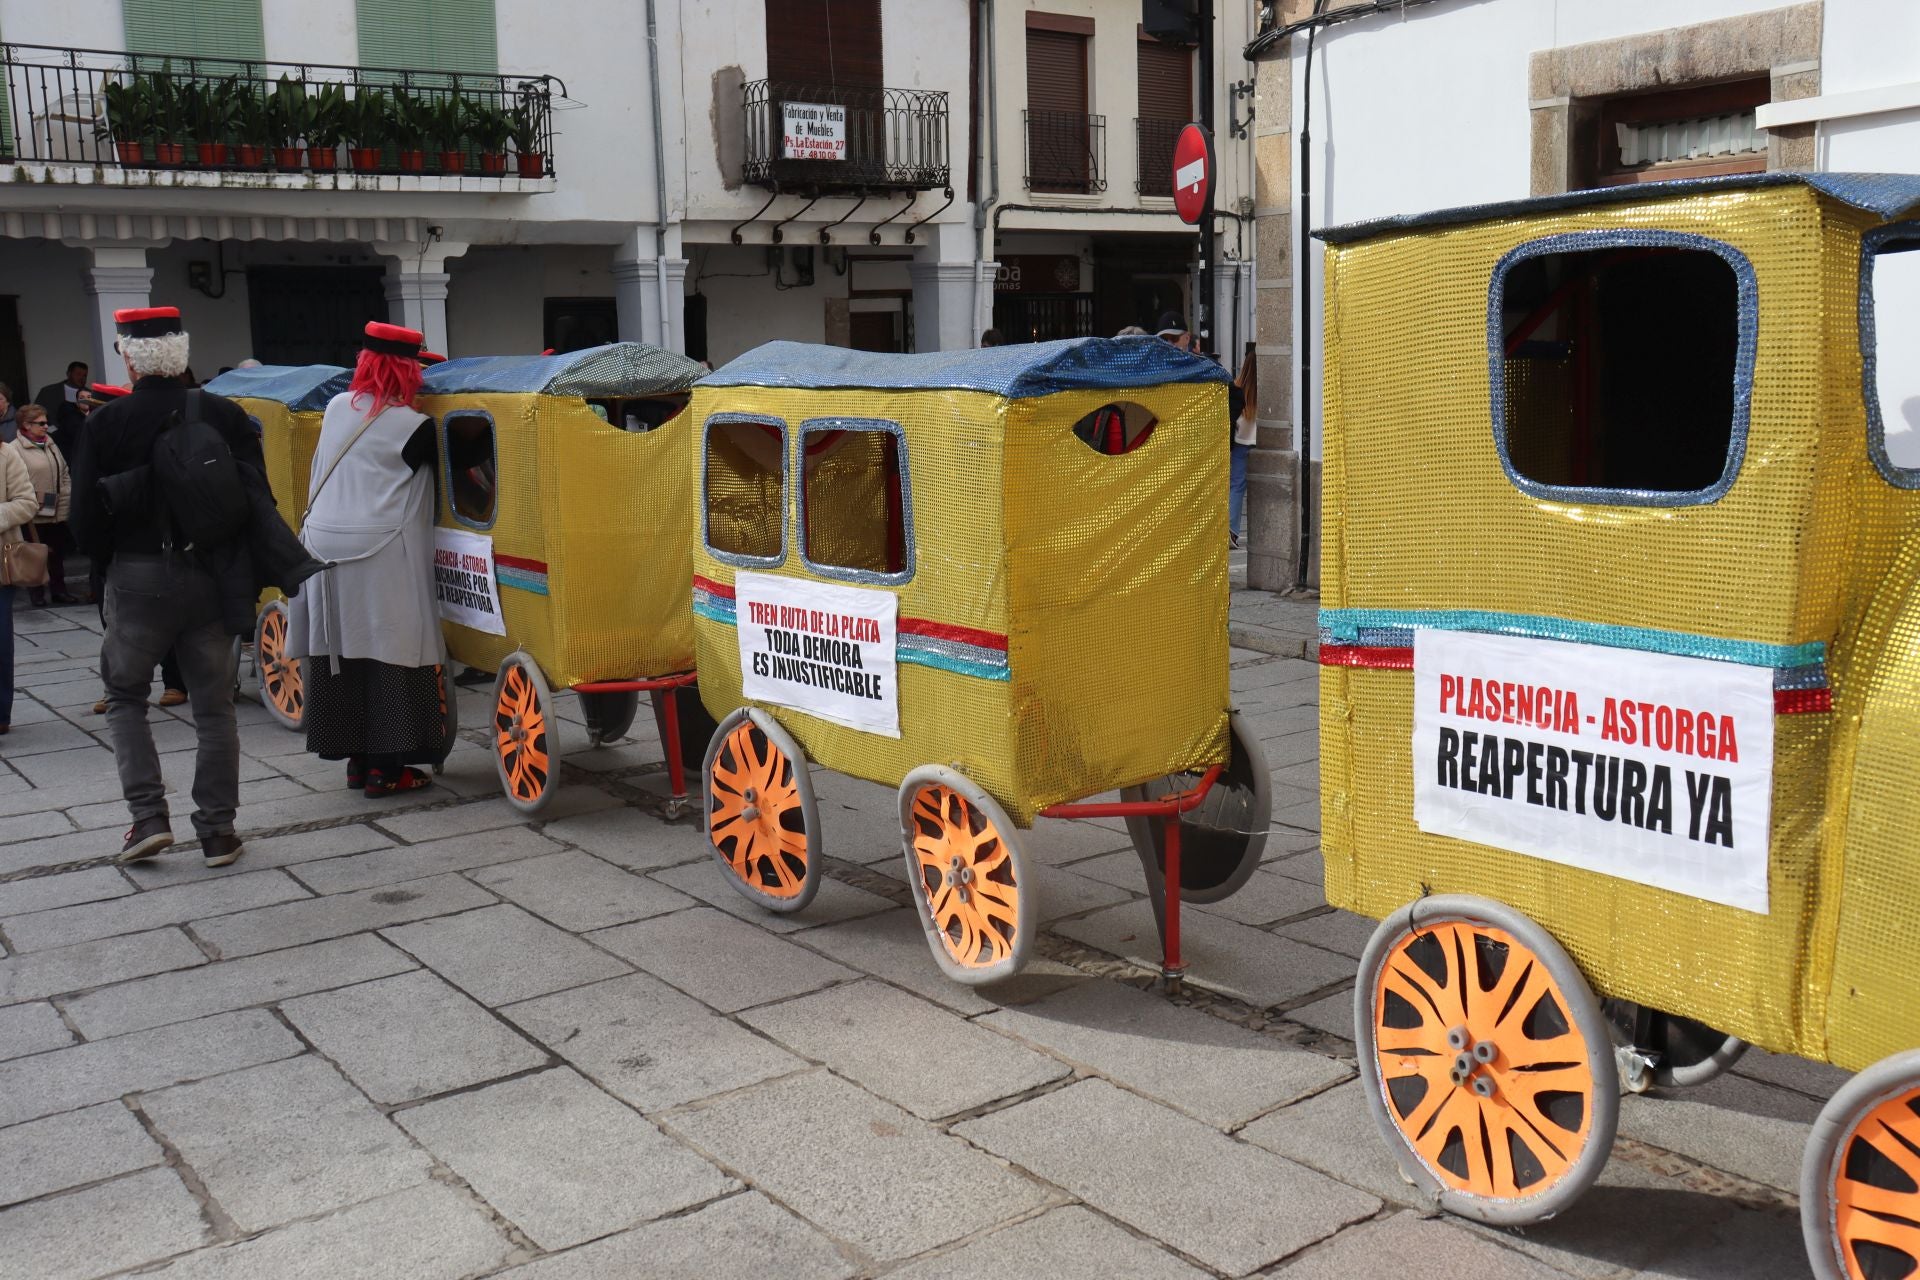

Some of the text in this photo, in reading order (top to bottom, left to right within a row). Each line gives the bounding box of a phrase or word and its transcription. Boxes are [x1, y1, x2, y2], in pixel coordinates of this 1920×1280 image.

[785, 103, 843, 122] Fabricación y Venta
[795, 121, 834, 137] de Muebles
[835, 140, 845, 151] 27
[993, 282, 1021, 290] omas
[434, 549, 459, 569] ASENCIA
[462, 553, 489, 575] ASTORGA
[434, 566, 491, 595] UCHAMOS POR
[436, 584, 495, 614] LA REAPERTURA
[748, 601, 881, 644] TREN RUTA DE LA PLATA
[764, 628, 864, 670] TODA DEMORA
[753, 651, 883, 700] ES INJUSTIFICABLE
[1439, 673, 1739, 763] PLASENCIA - ASTORGA
[1437, 726, 1735, 849] REAPERTURA YA
